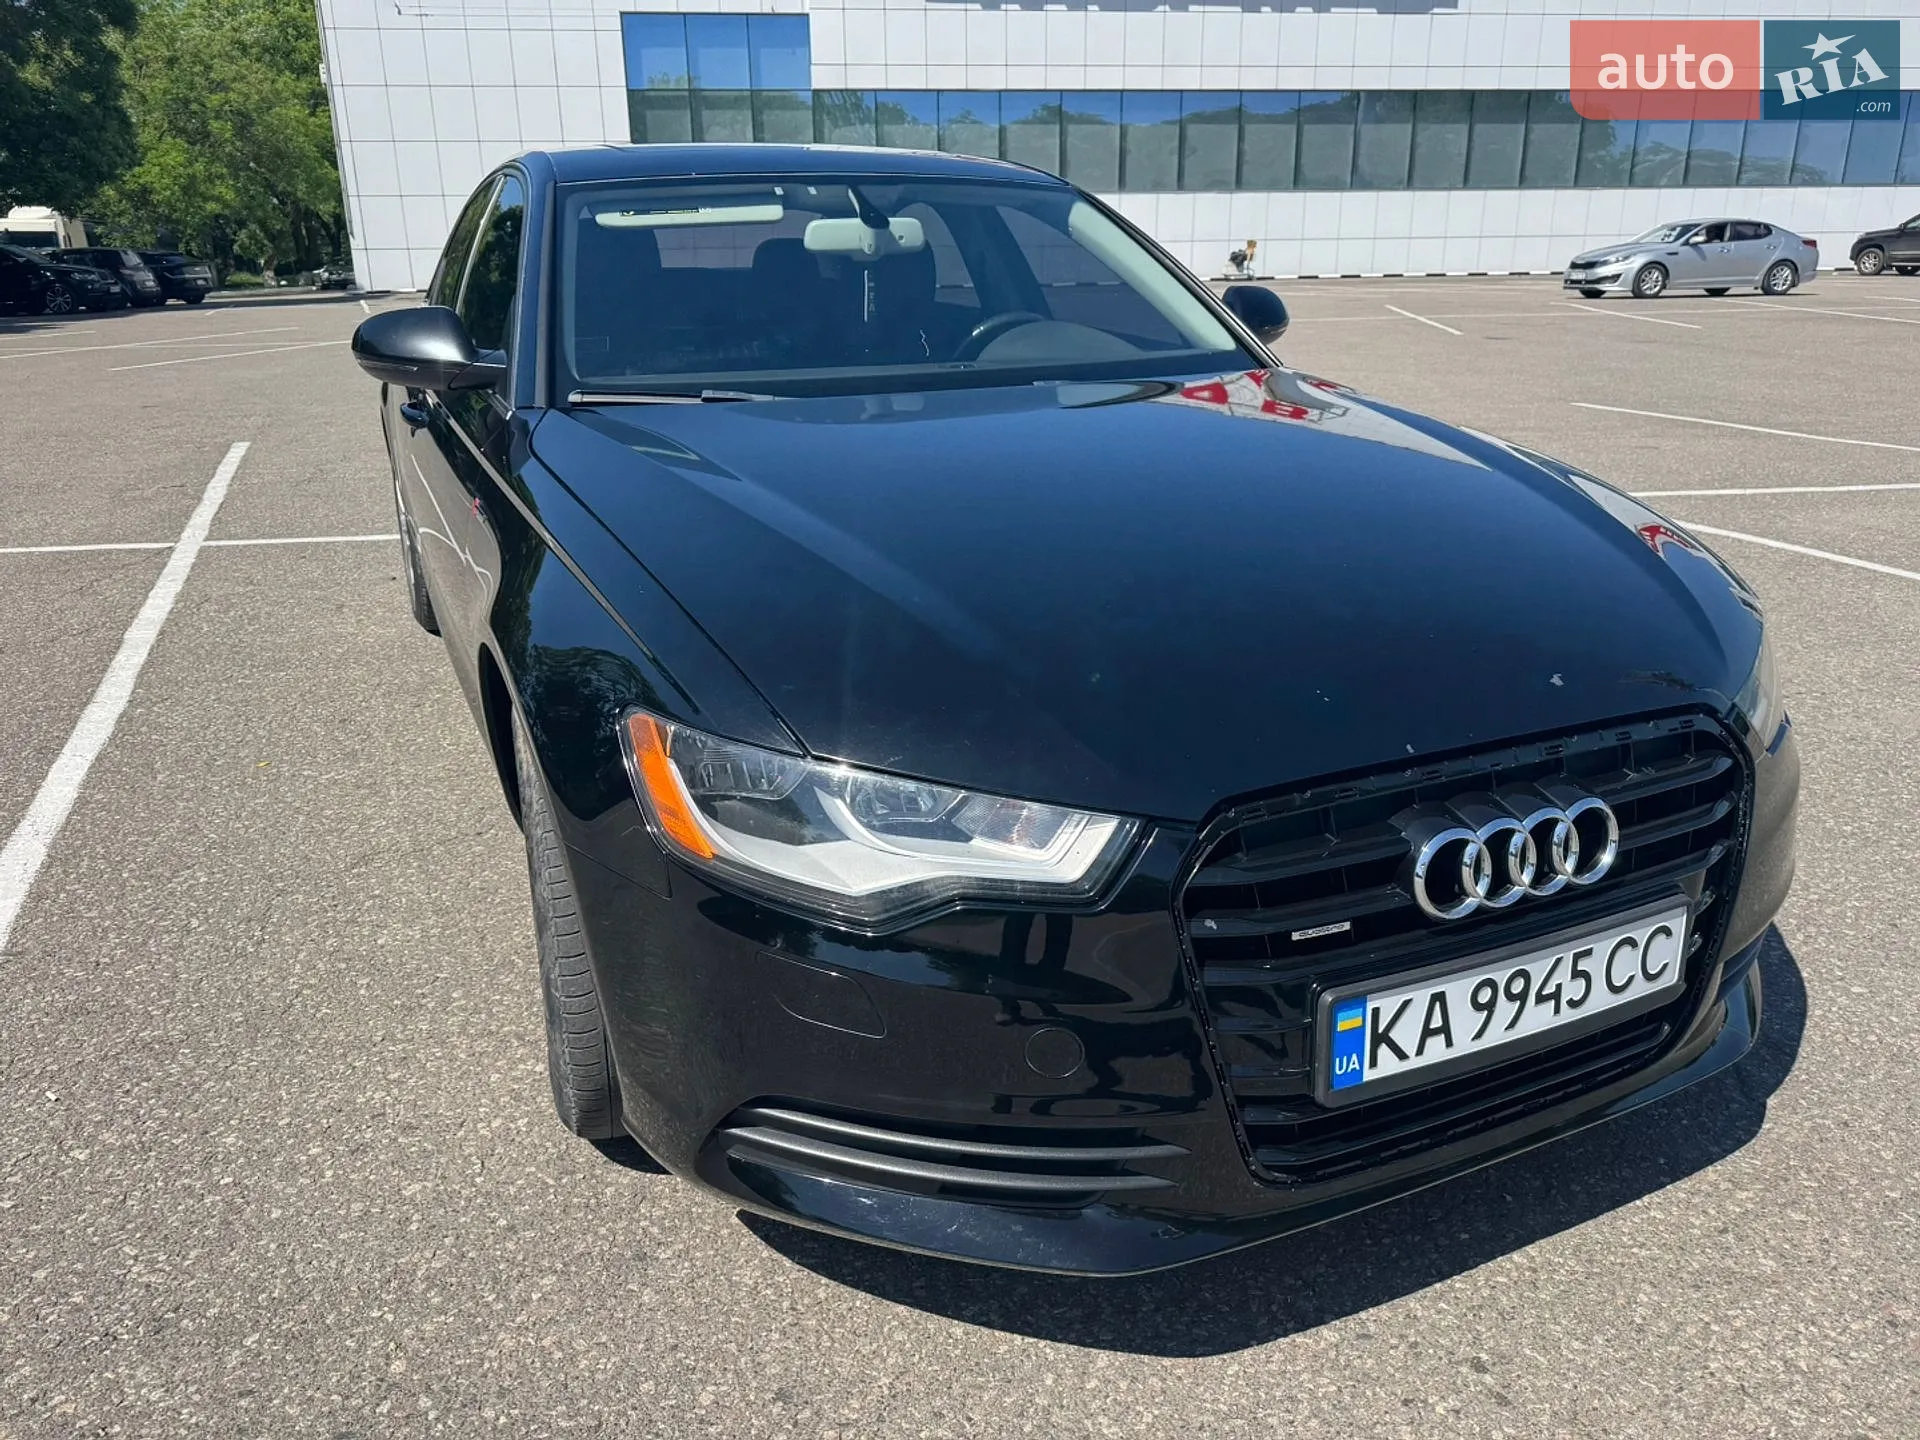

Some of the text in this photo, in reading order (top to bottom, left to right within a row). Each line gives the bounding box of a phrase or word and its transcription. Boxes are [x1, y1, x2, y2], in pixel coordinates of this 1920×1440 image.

[1368, 922, 1673, 1070] KA 9945 CC
[1334, 1053, 1361, 1075] UA
